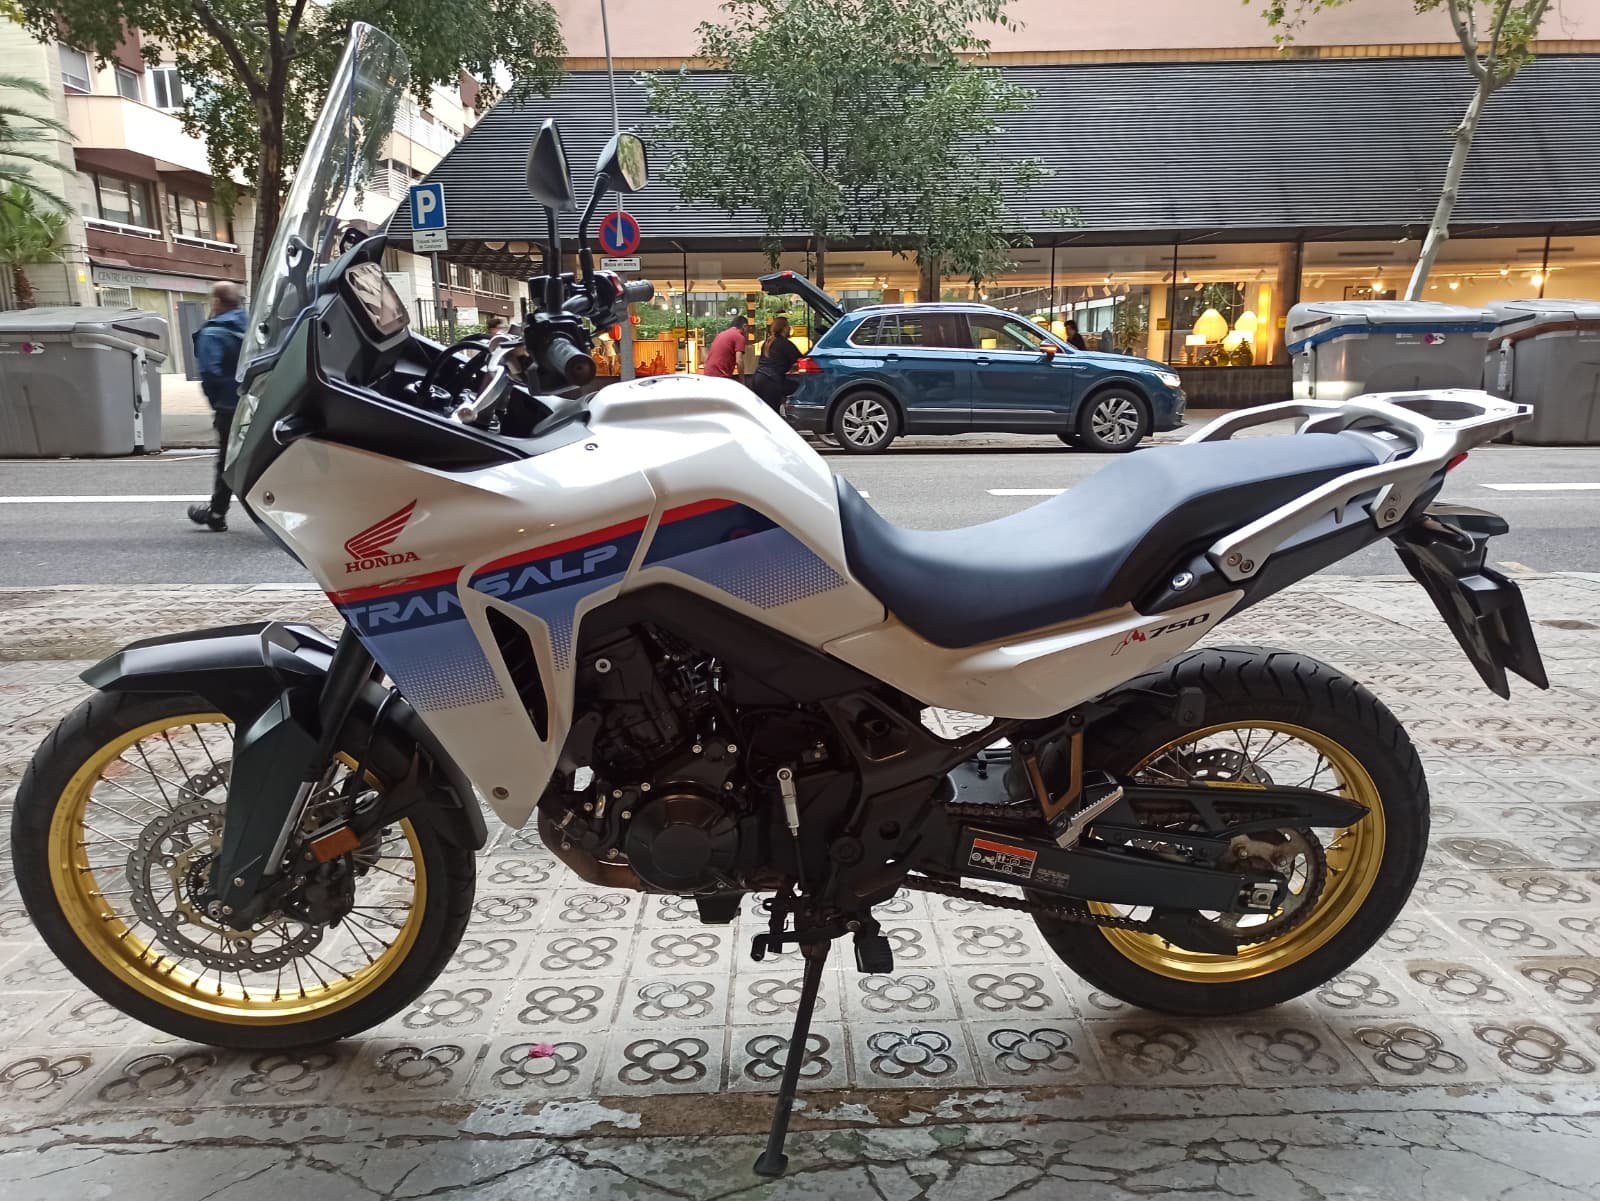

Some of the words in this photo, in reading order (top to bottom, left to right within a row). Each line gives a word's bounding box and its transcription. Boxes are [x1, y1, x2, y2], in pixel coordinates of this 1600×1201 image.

[416, 190, 436, 224] P
[345, 551, 420, 573] HONDA
[341, 545, 617, 628] TRANSALP
[1150, 613, 1210, 639] 750
